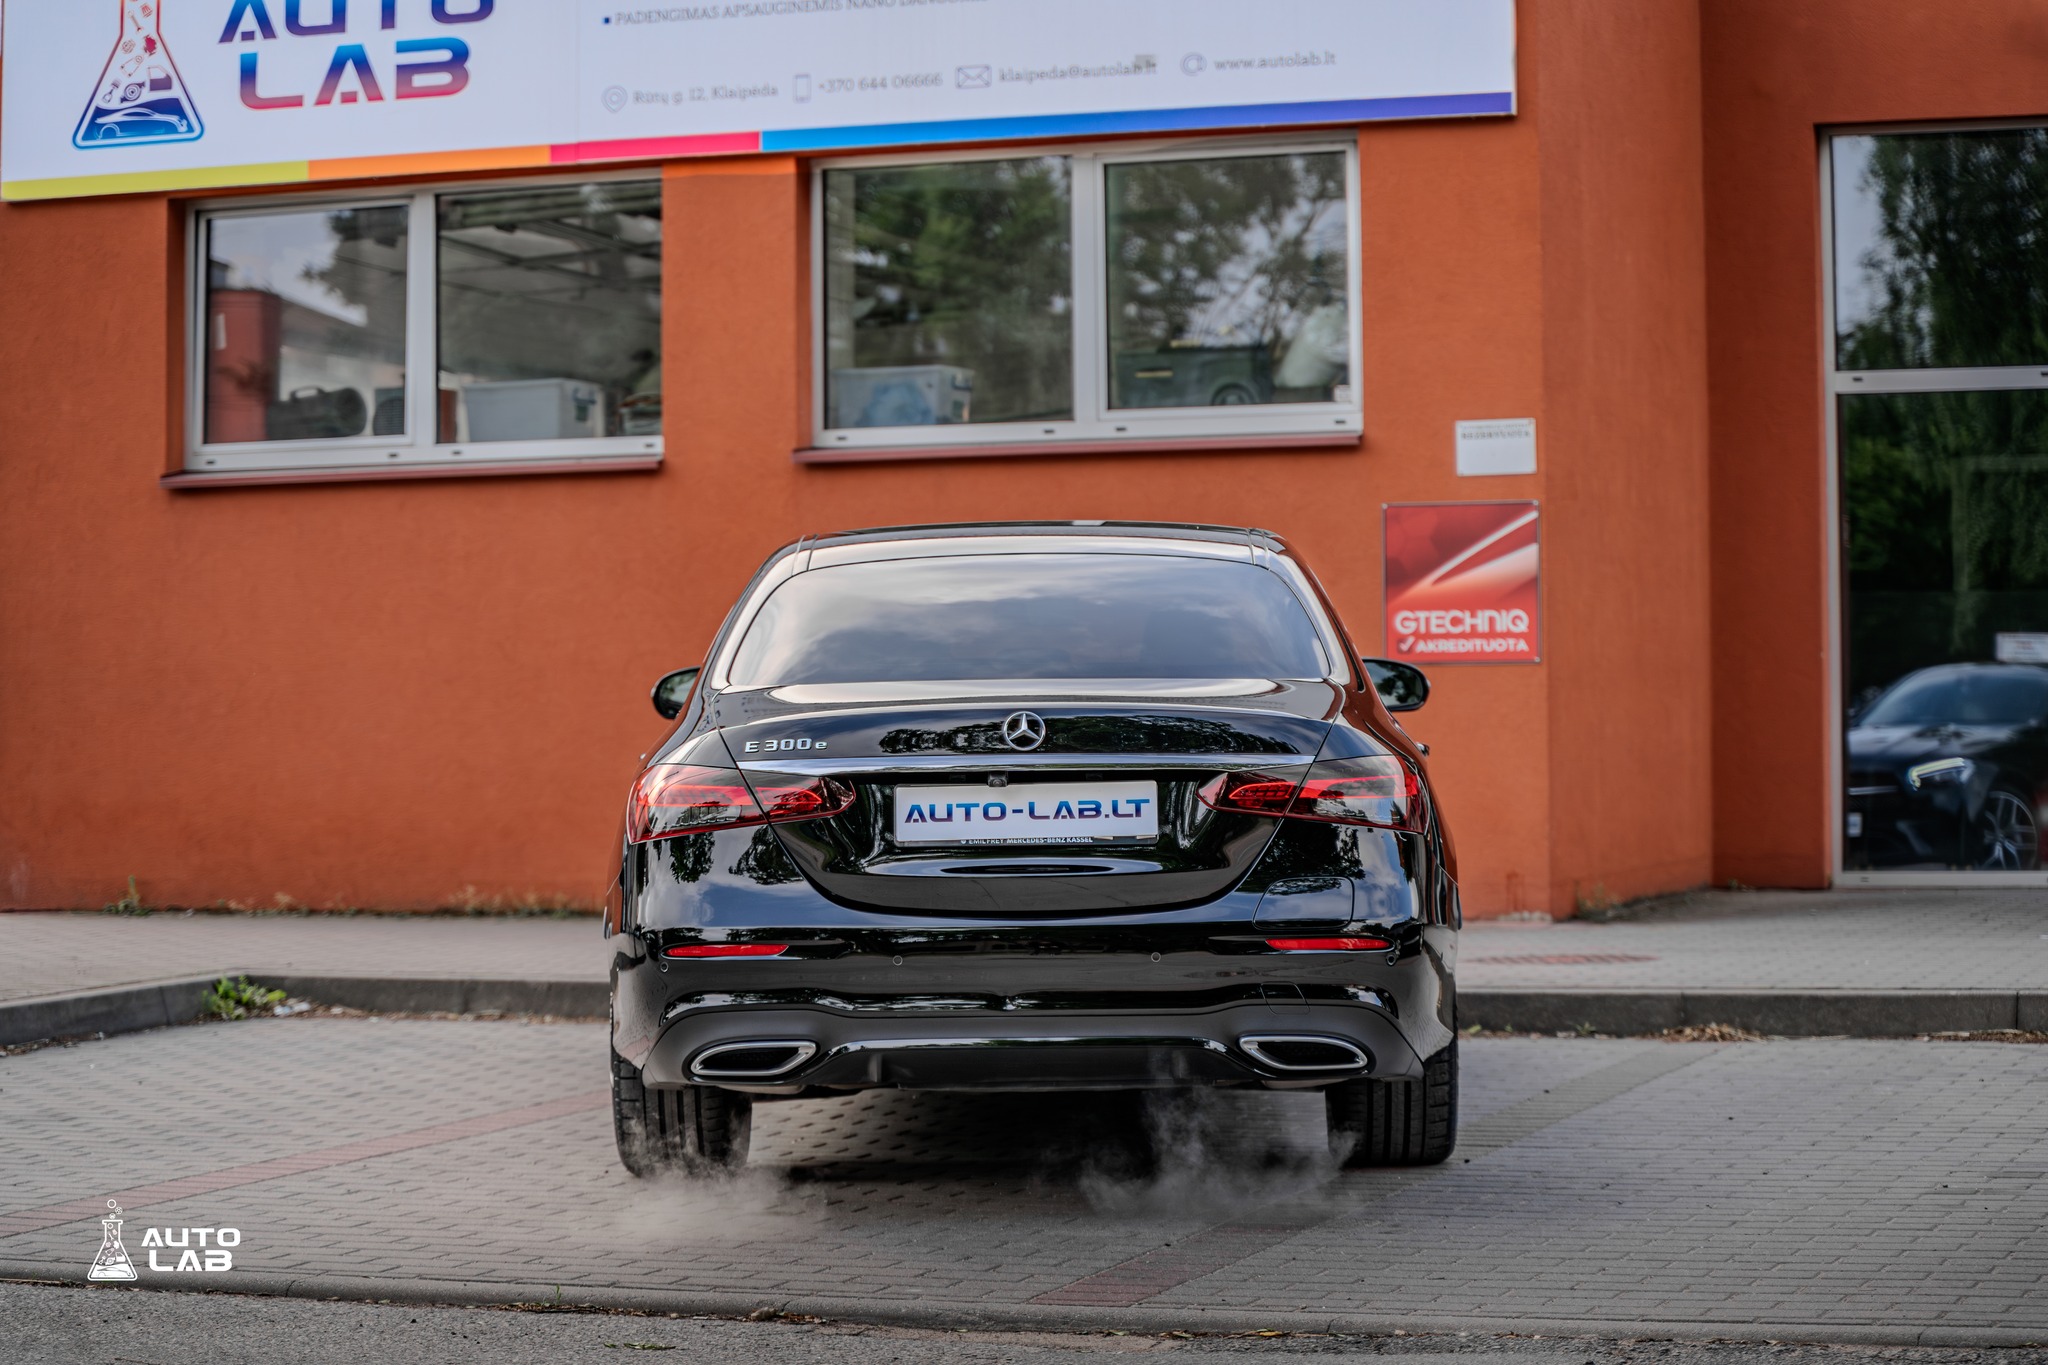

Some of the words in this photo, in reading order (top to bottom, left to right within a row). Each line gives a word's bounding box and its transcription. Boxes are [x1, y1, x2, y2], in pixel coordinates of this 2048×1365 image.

[1214, 51, 1337, 71] www.autolab.lt
[239, 37, 470, 110] LAB
[857, 76, 888, 90] 644
[1395, 609, 1529, 634] GTECHNIQ
[1415, 638, 1529, 653] AKREDITUOTA
[745, 741, 760, 753] E
[763, 738, 813, 751] 300
[905, 798, 1151, 824] AUTO-LAB.LT
